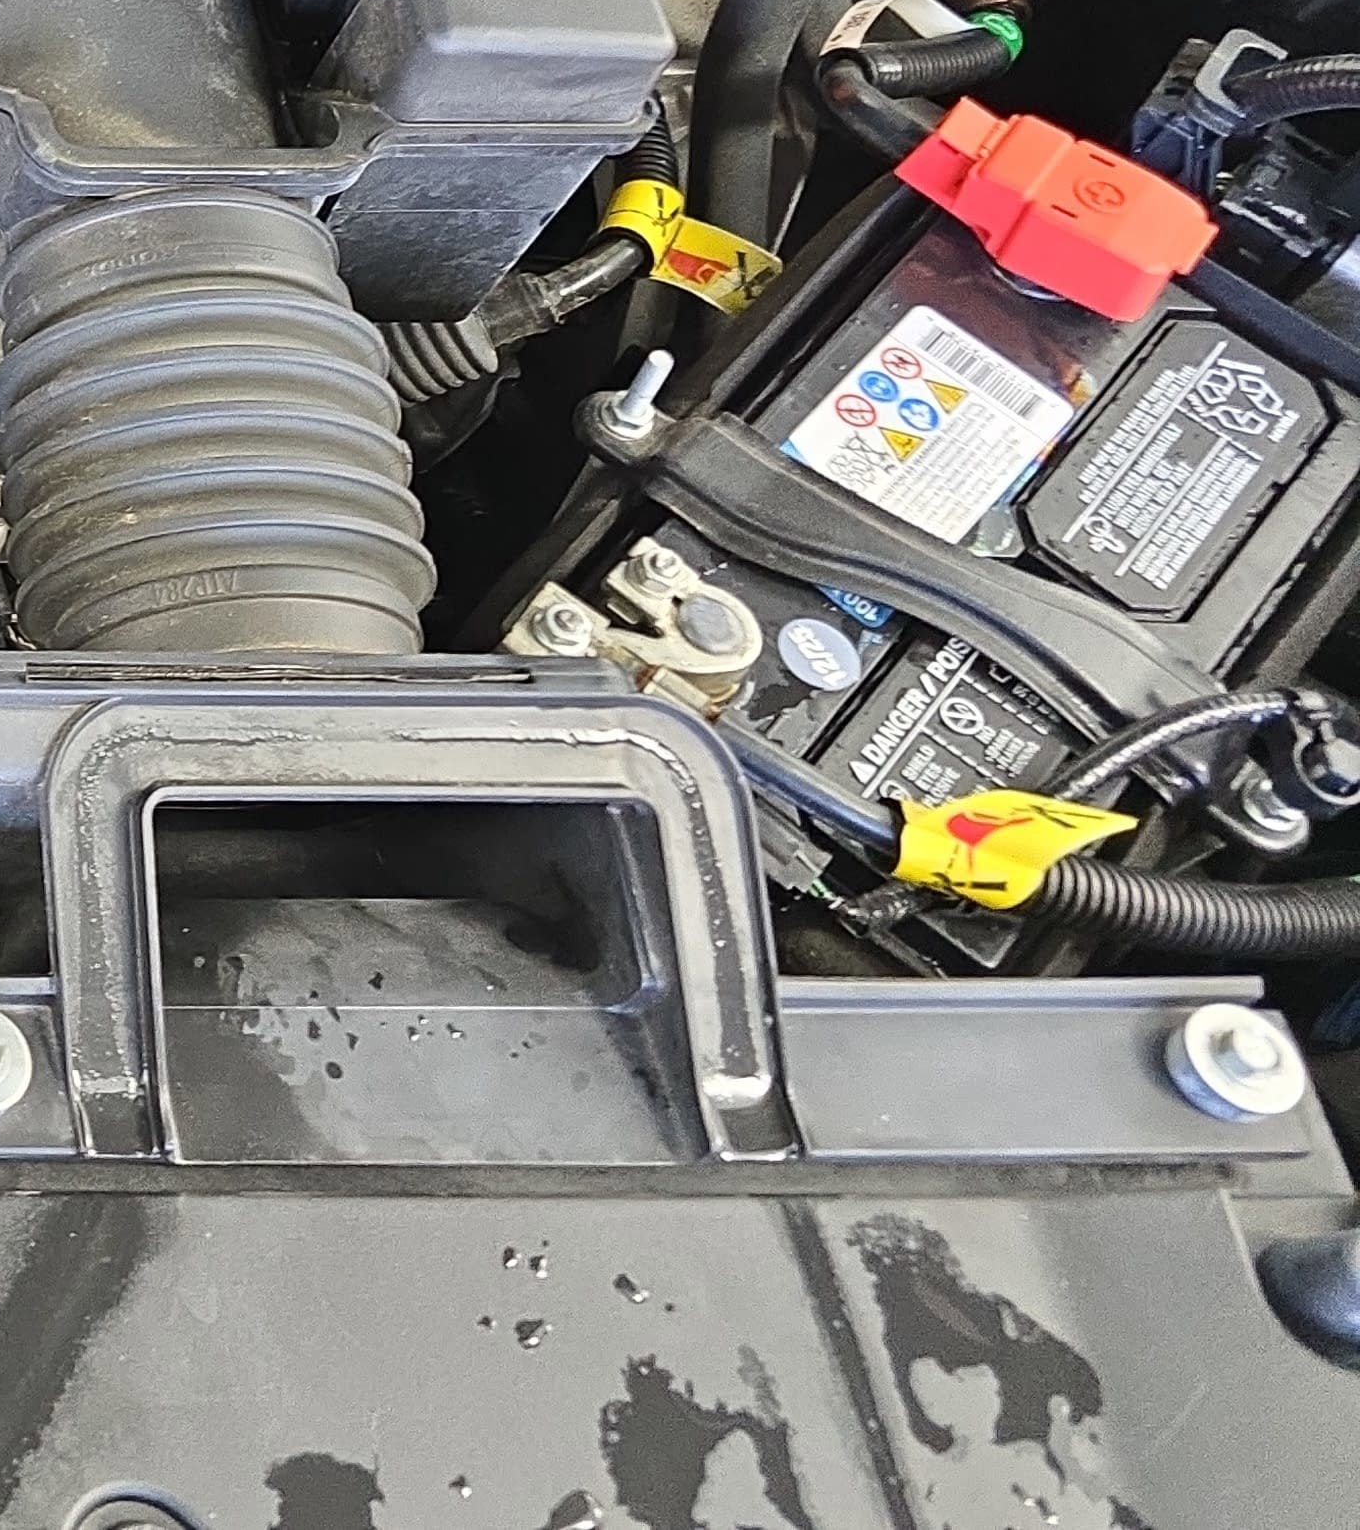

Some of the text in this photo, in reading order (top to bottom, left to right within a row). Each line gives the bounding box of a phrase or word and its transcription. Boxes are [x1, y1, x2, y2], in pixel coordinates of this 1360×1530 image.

[786, 623, 848, 687] 12/25
[899, 743, 937, 782] SHIELD
[914, 761, 944, 792] EYES
